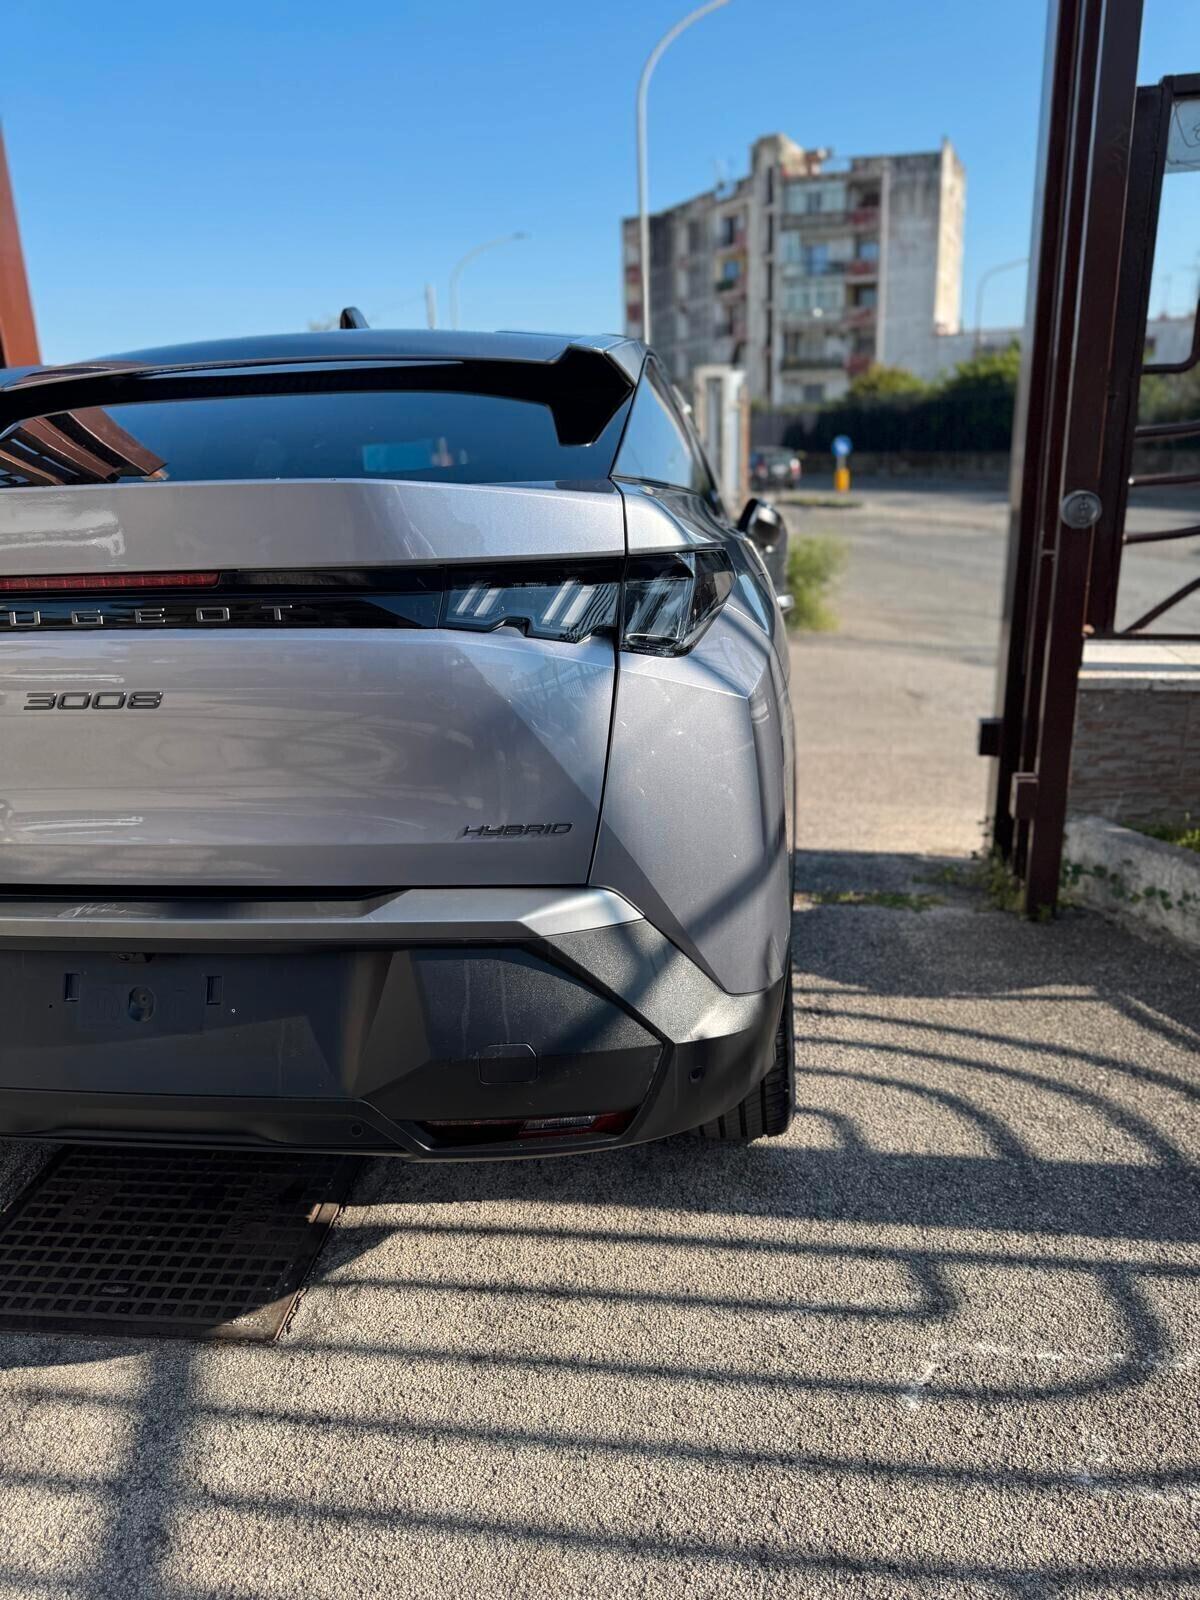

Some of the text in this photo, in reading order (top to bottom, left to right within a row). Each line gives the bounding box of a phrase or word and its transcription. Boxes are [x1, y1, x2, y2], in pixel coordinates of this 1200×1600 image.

[9, 605, 293, 627] UGEOT
[23, 691, 164, 711] 3008
[463, 823, 573, 837] HYBRID
